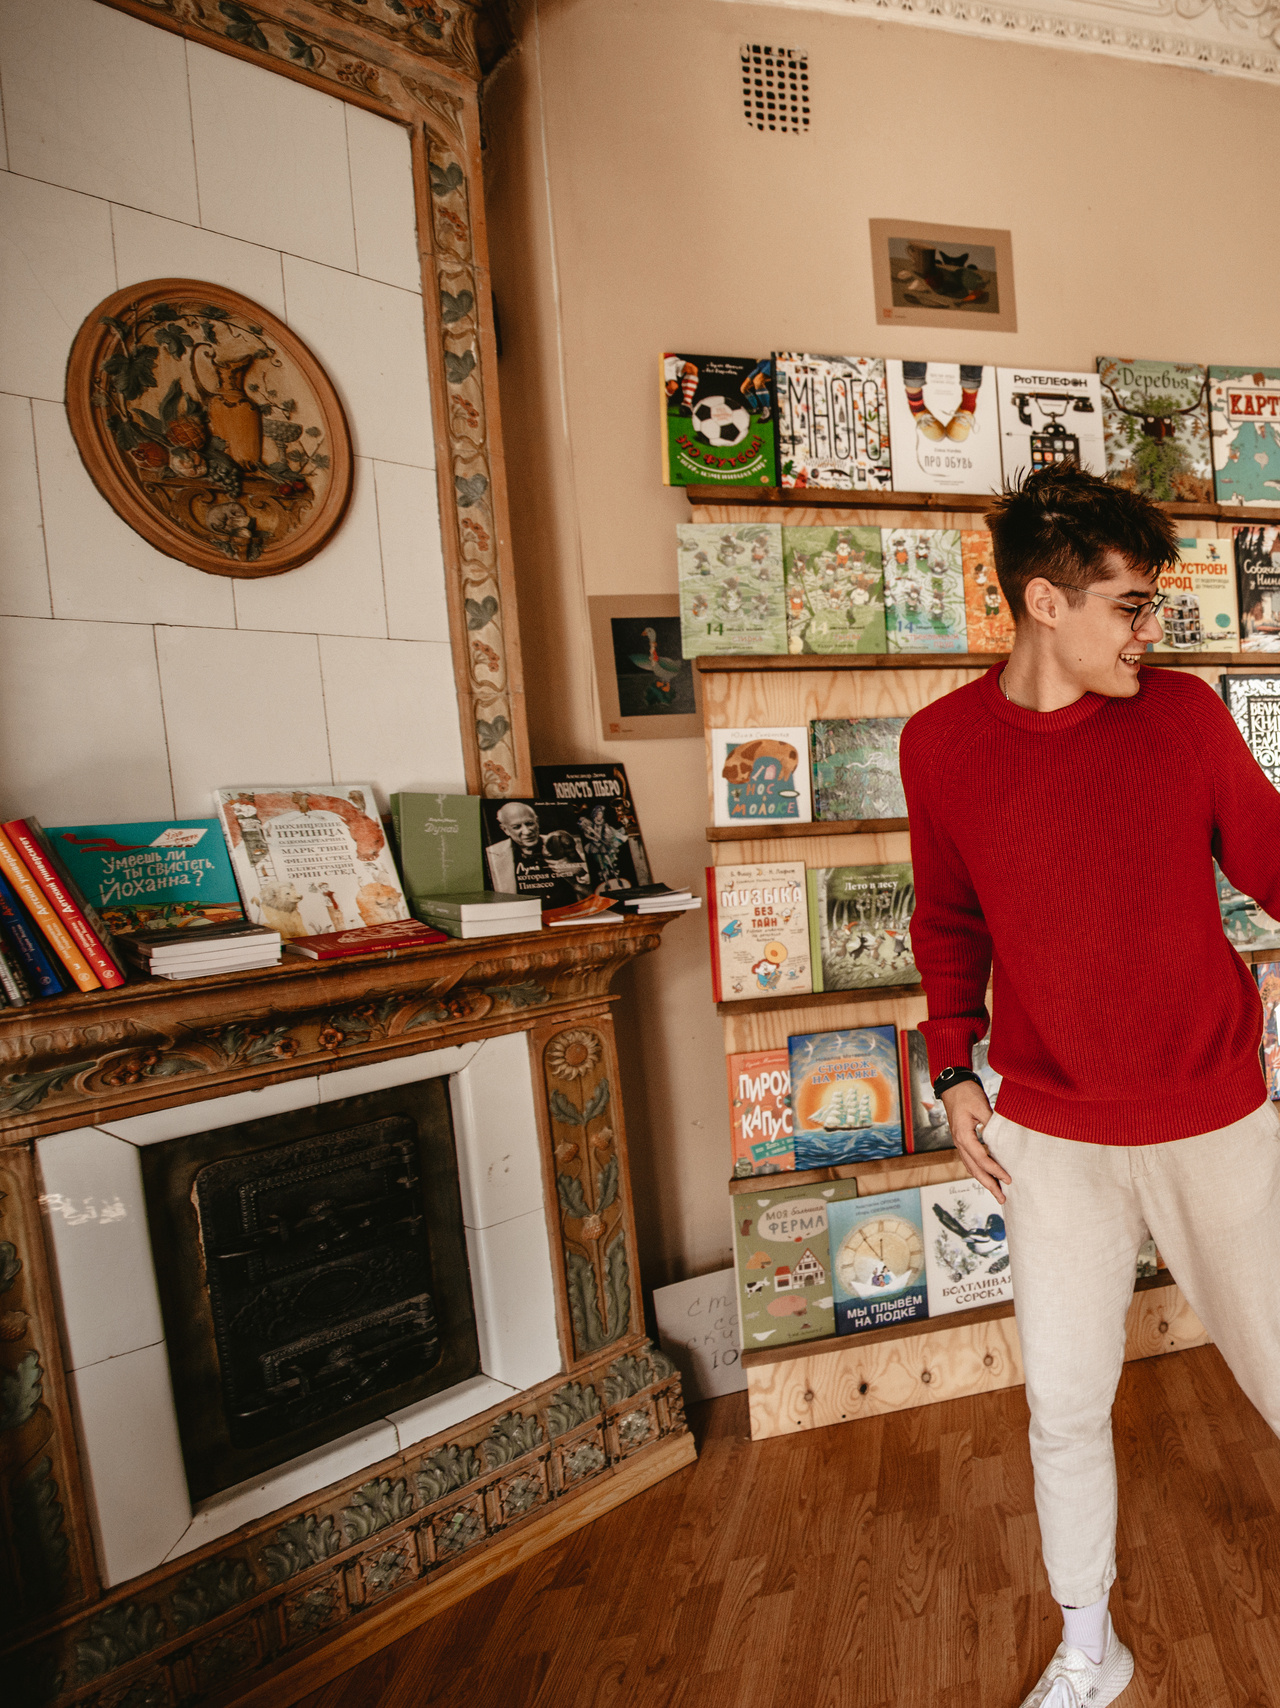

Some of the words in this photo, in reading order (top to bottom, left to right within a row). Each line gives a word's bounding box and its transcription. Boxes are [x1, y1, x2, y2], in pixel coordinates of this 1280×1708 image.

[1117, 367, 1189, 395] Деревья
[788, 376, 881, 460] МНОГО
[675, 434, 701, 457] ЭТО
[703, 434, 766, 468] ФУТБОЛ!
[924, 455, 942, 468] ПРО
[944, 456, 973, 469] ОБУВЬ
[1180, 562, 1228, 576] УСТРОЕН
[706, 622, 724, 636] 14
[810, 621, 828, 634] 14
[897, 620, 913, 634] 14
[552, 780, 593, 799] ЮНОСТЬ
[592, 778, 621, 797] ПЬЕРО
[745, 783, 774, 797] НОС
[731, 802, 796, 816] МОЛОКЕ
[274, 821, 342, 830] ПОХИЩЕНИЕ
[276, 828, 344, 839] ПРИНЦА
[281, 845, 316, 855] МАРК
[317, 844, 349, 854] ТВЕН
[19, 835, 55, 884] университет
[101, 854, 163, 875] Умеешь
[325, 854, 353, 863] СТЕД
[287, 871, 322, 880] ЭРИН
[323, 868, 357, 877] СТЕД
[516, 871, 550, 882] которая
[518, 881, 555, 891] Пикассо
[844, 881, 868, 891] Лето
[869, 882, 876, 890] в
[877, 880, 899, 891] лесу
[22, 882, 49, 919] Детский
[47, 880, 75, 916] Детский
[721, 886, 801, 908] МУЗЫКА
[754, 906, 773, 917] БЕЗ
[751, 917, 778, 929] ТАЙН
[818, 1060, 871, 1075] СТОРОЖ
[812, 1073, 831, 1085] НА
[835, 1068, 878, 1082] МАЯКЕ
[765, 1209, 788, 1222] МОЯ
[768, 1214, 825, 1235] ФЕРМА
[942, 1274, 1013, 1298] БОЛТЛИВАЯ
[955, 1288, 1004, 1305] СОРОКА
[847, 1306, 869, 1319] МЫ
[871, 1294, 923, 1314] ПЛЫВЁМ
[855, 1316, 873, 1329] НА
[875, 1306, 917, 1325] ЛОДКЕ
